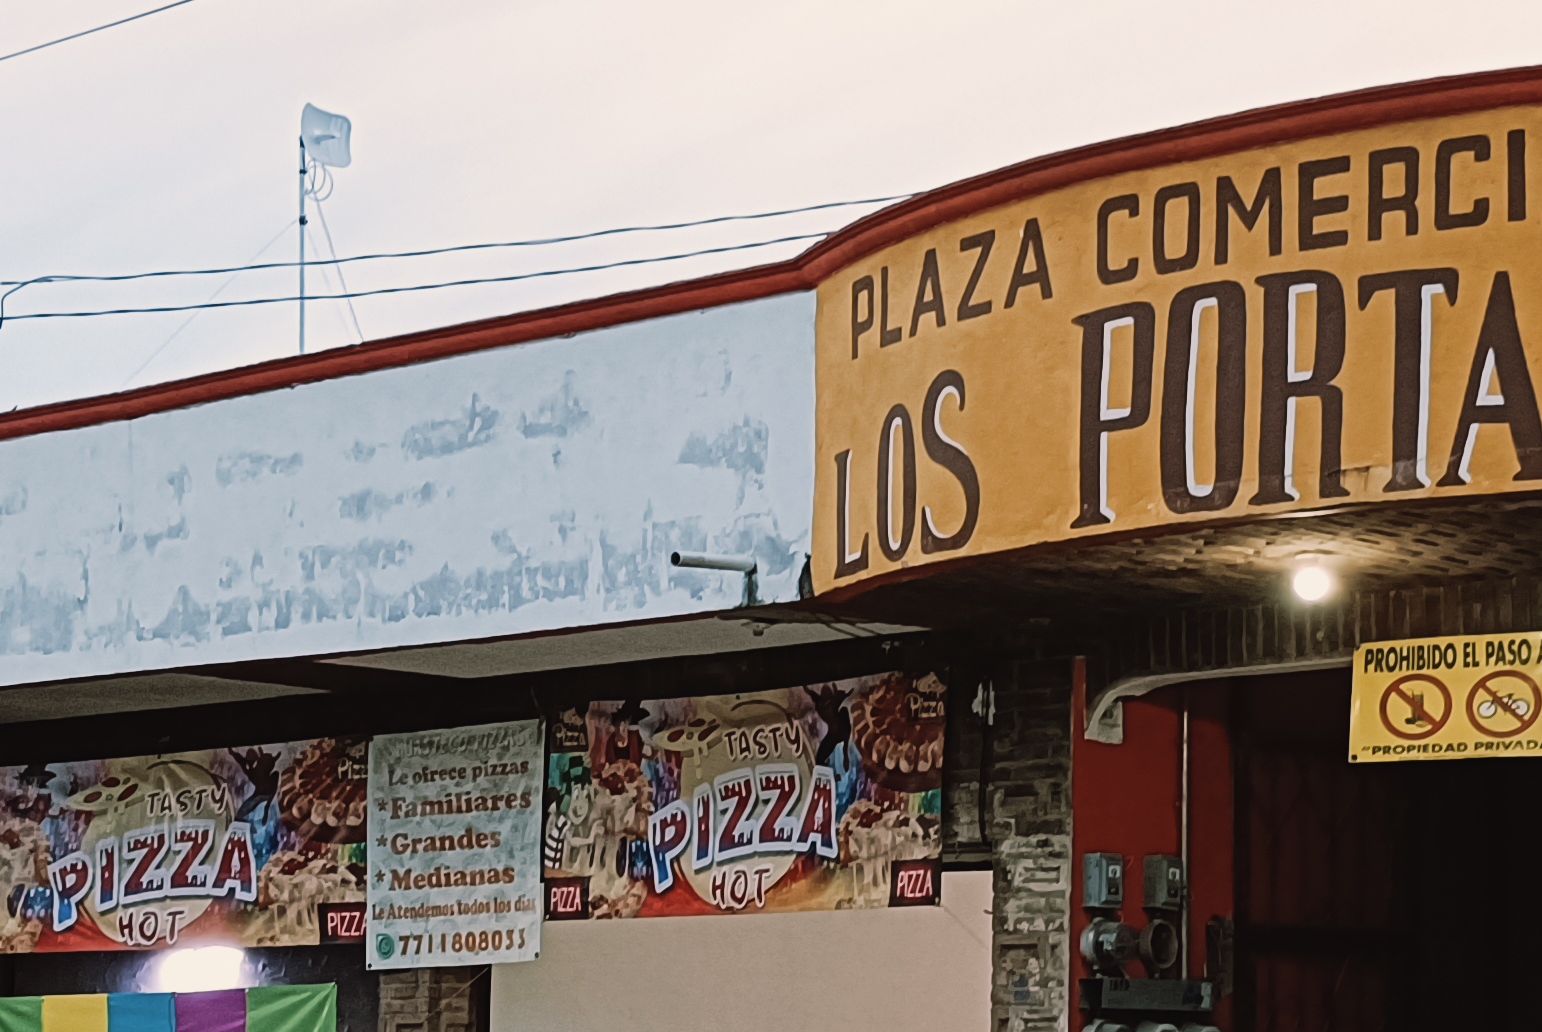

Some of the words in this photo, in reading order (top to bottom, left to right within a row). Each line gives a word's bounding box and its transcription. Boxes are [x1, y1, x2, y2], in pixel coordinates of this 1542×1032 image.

[850, 218, 1052, 360] PLAZA
[834, 369, 980, 577] LOS
[1363, 642, 1458, 674] PROHIBIDO
[1462, 641, 1480, 669] EL
[1485, 638, 1533, 667] PASO
[723, 720, 803, 762] TASTY
[338, 757, 368, 780] Pizz
[412, 764, 467, 784] ofrece
[471, 759, 530, 782] pizzas
[146, 783, 228, 818] TASTY
[648, 763, 838, 893] PIZZA
[49, 820, 258, 931] PIZZA
[711, 864, 772, 910] HOT
[897, 869, 933, 898] PIZZA
[372, 904, 385, 920] Le
[386, 902, 455, 920] Atendemos
[457, 899, 491, 915] todos
[494, 896, 512, 913] los
[550, 886, 582, 914] PIZZA
[117, 907, 186, 946] HOT
